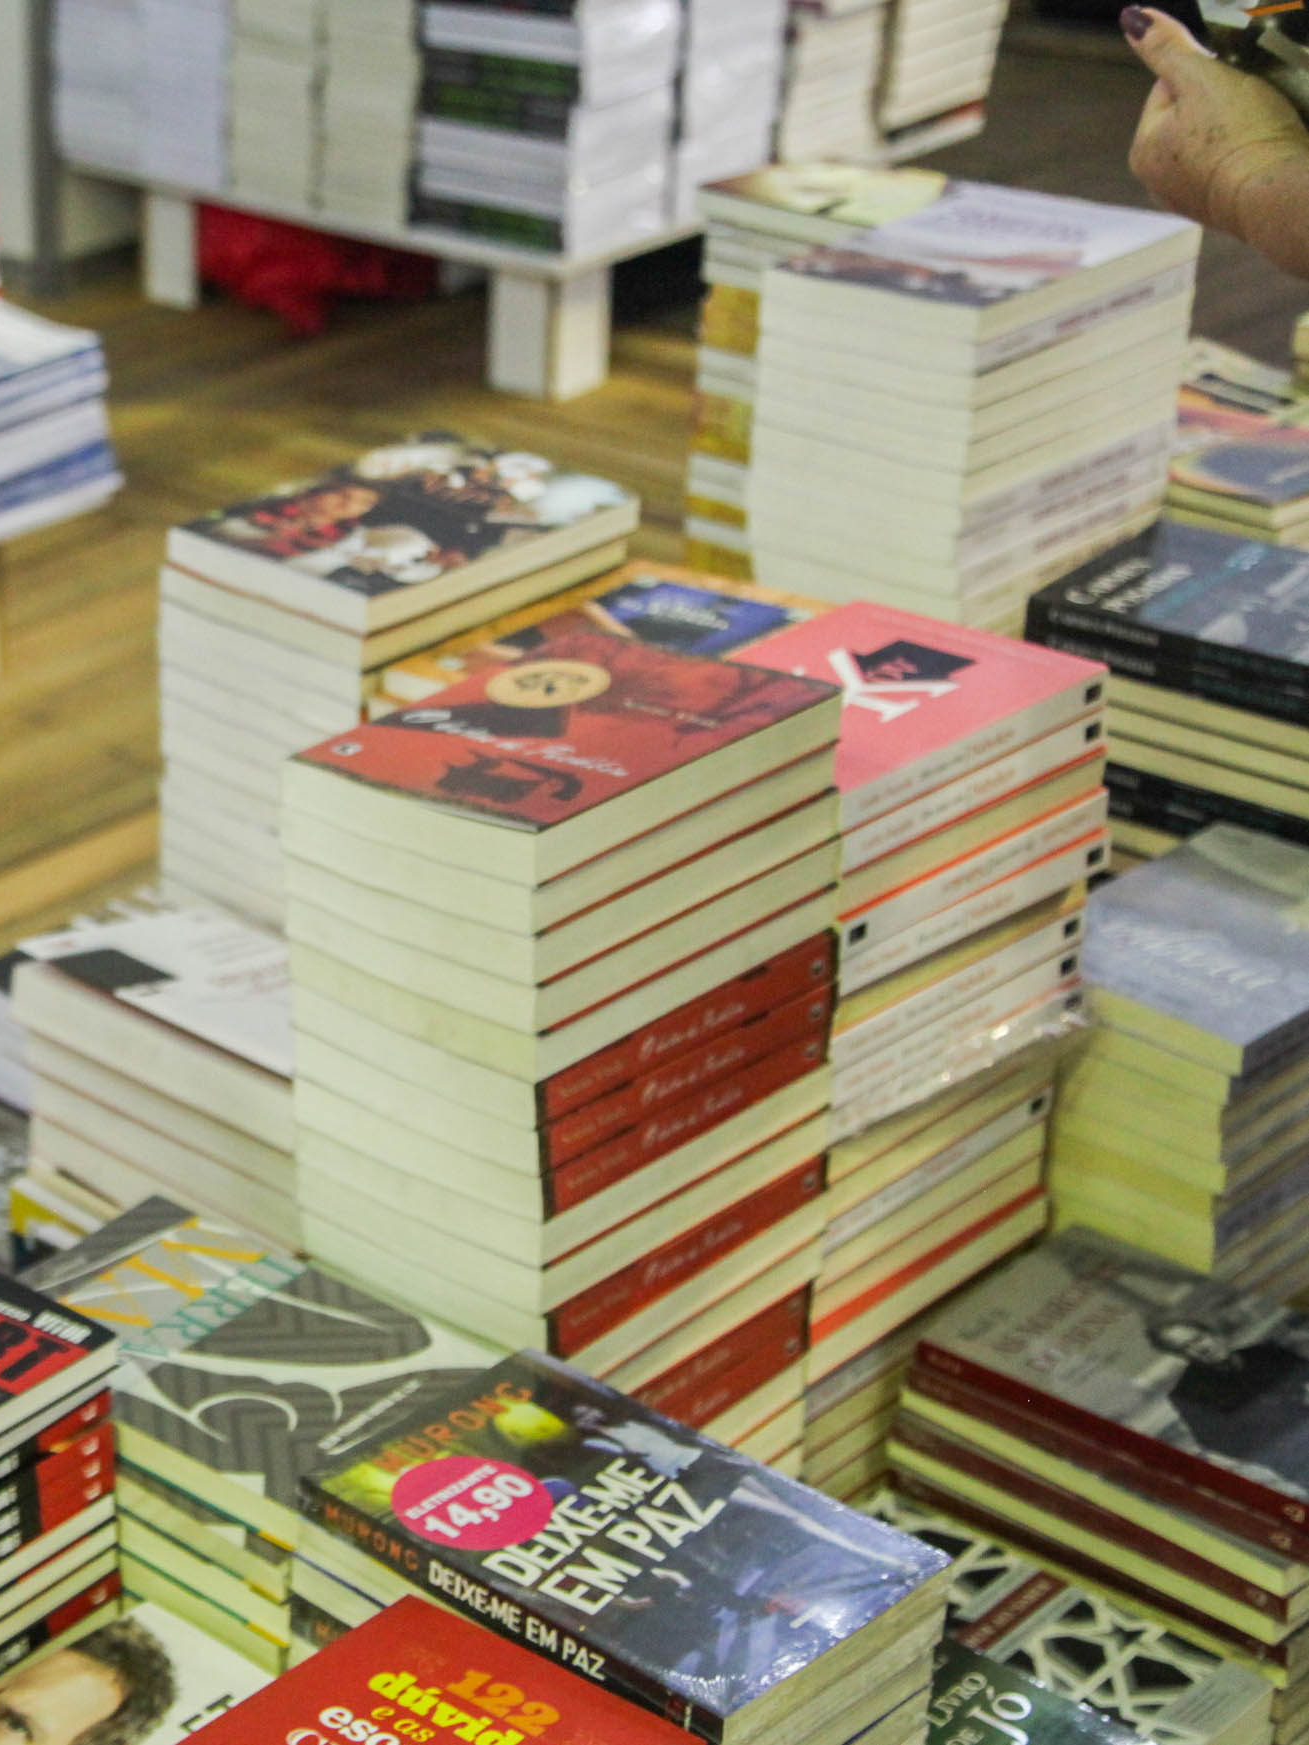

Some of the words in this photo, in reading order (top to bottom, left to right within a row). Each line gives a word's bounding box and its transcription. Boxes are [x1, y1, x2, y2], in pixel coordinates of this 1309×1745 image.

[424, 1473, 534, 1538] 14,90
[481, 1457, 666, 1587] DEIXE-ME
[538, 1548, 642, 1616] EM
[605, 1481, 728, 1562] PAZ
[428, 1559, 522, 1633] DEIXE-ME
[525, 1617, 558, 1653] EM
[562, 1638, 607, 1681] PAZ
[393, 1718, 435, 1743] as
[446, 1669, 560, 1736] 122
